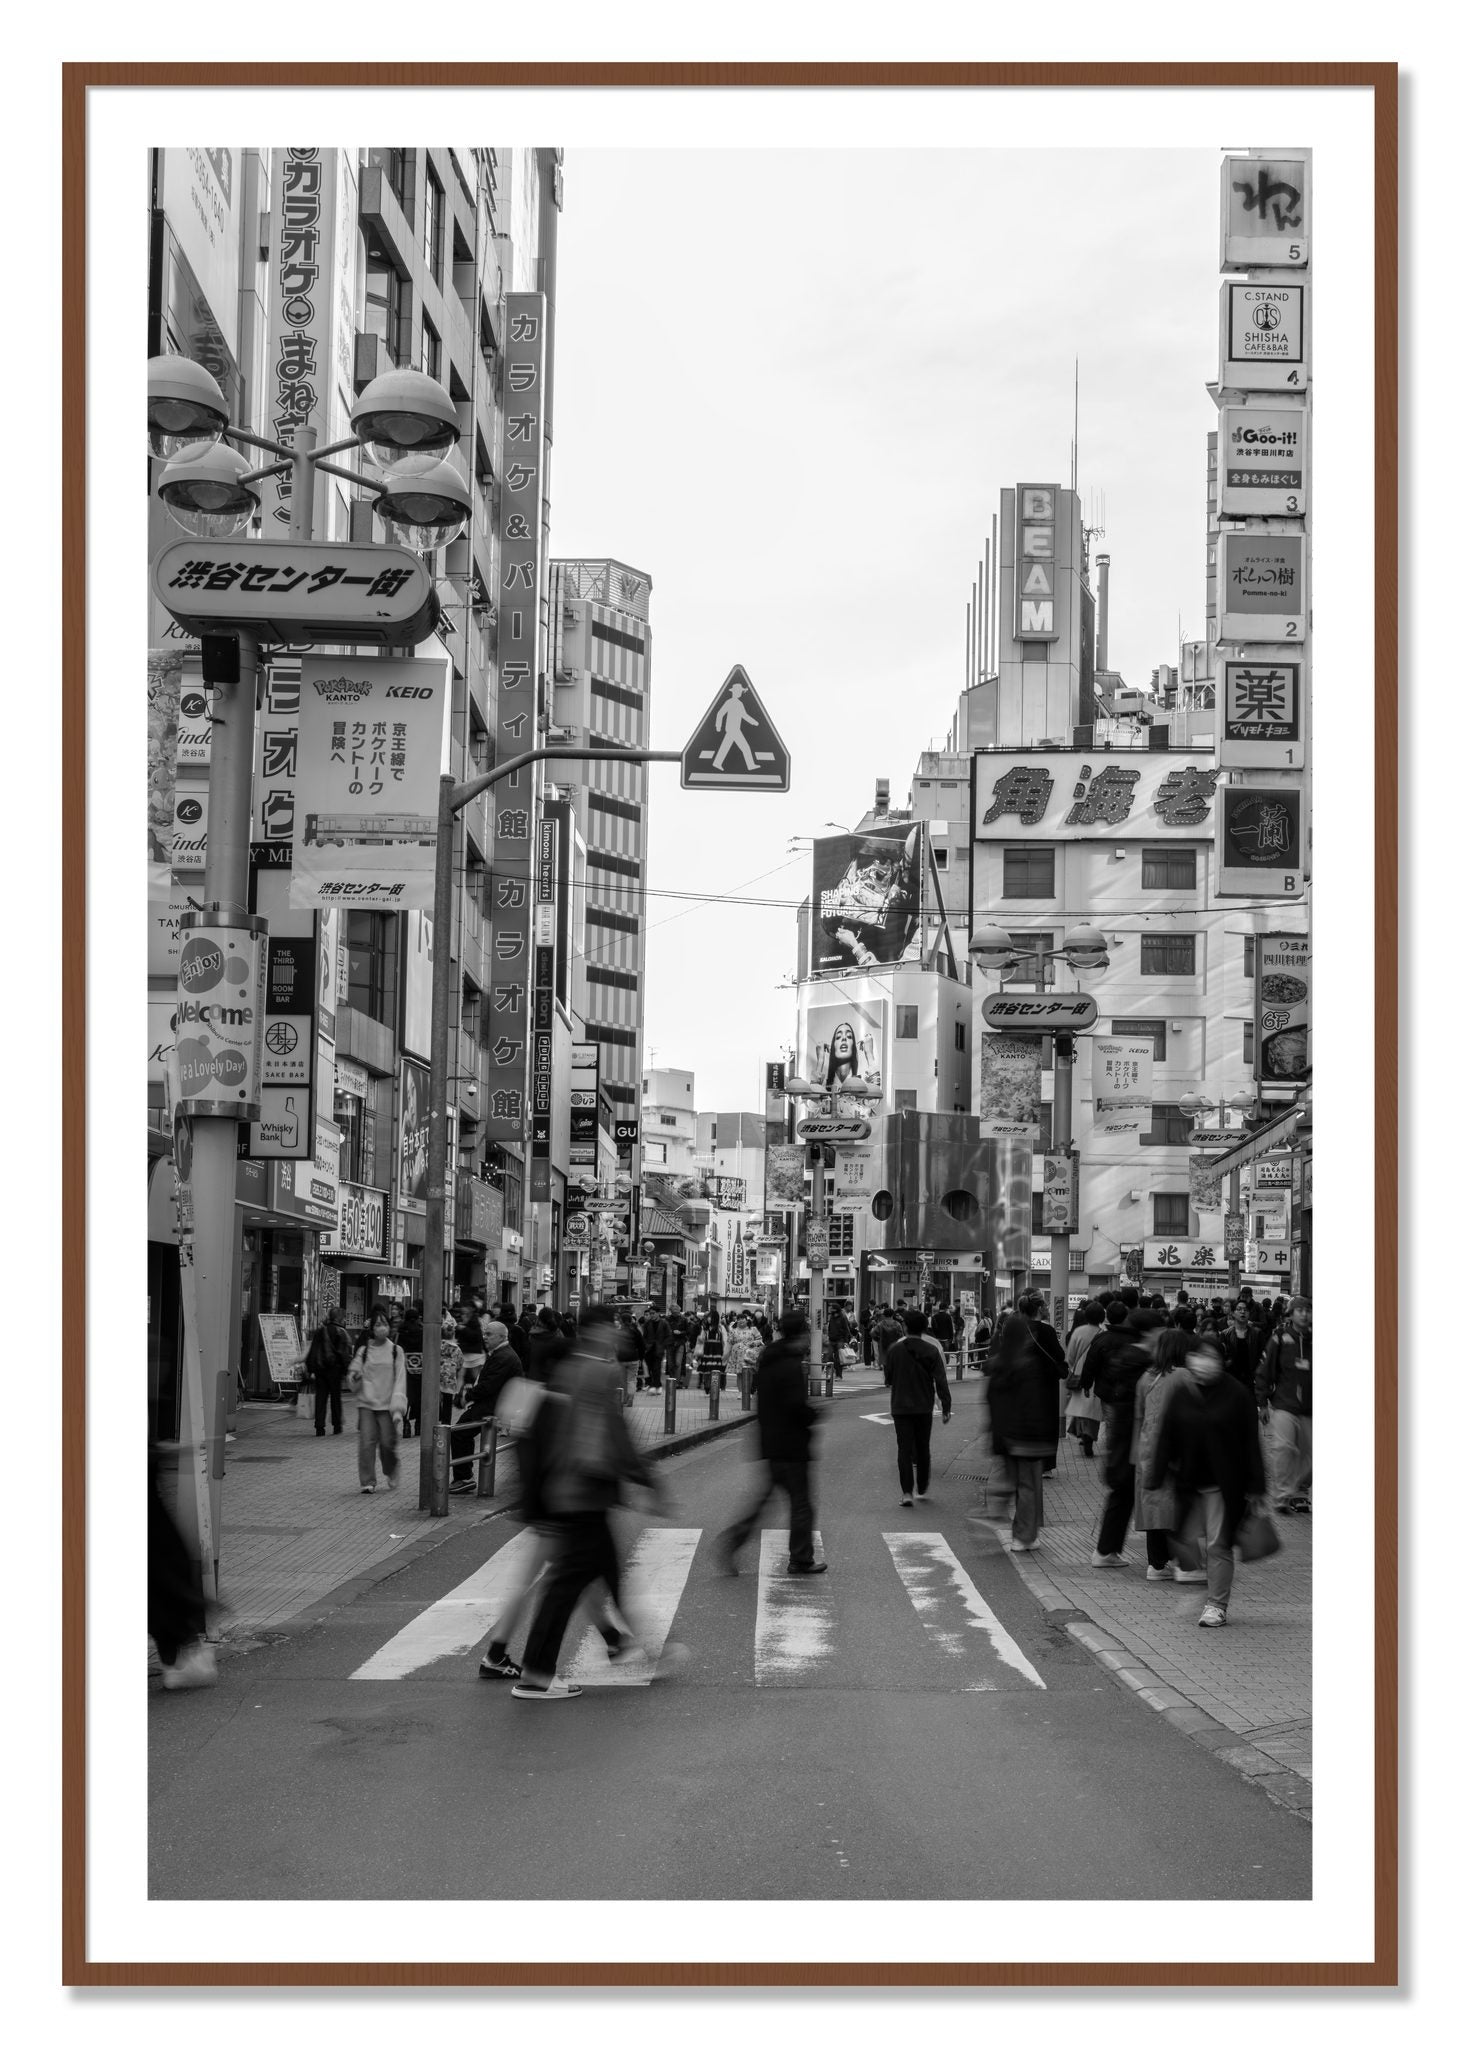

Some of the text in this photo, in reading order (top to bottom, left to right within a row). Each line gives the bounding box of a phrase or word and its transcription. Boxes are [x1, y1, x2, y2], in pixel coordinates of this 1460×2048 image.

[281, 160, 322, 299] カラオケ
[1289, 245, 1301, 261] 5
[1244, 292, 1289, 302] C.STAND
[1244, 332, 1289, 343] SHISHA
[1244, 343, 1289, 352] CAFE&BAR
[1287, 370, 1299, 385] 4
[1243, 428, 1297, 445] Goo-it!
[1231, 473, 1298, 485] 全身もみほぐし
[1286, 495, 1298, 512] 3
[1023, 489, 1053, 633] BEAM
[168, 559, 416, 598] 渋谷センター街
[1242, 589, 1287, 597] Pomme-no-ki
[1285, 621, 1297, 637] 2
[325, 694, 361, 702] KANTO
[385, 686, 434, 700] KEIO
[1235, 669, 1286, 721] 薬
[1229, 723, 1291, 738] マツモトキヨシ
[330, 721, 347, 764] 冒険へ
[181, 748, 206, 758] 渋谷店
[349, 721, 366, 795] カントーの
[368, 721, 387, 796] ポケパーク
[390, 722, 407, 782] 京王線で
[1285, 748, 1293, 764] 1
[982, 764, 1220, 826] 角海老
[1230, 803, 1290, 852] 一蘭
[177, 854, 202, 864] 渋谷店
[542, 824, 551, 899] kimono hearts
[317, 882, 406, 896] 渋谷センター街
[1284, 875, 1296, 891] B
[272, 957, 295, 965] THIRD
[819, 955, 843, 963] SALOMON
[181, 951, 221, 986] Enjoy
[272, 985, 294, 993] ROOM
[539, 951, 551, 1025] disk union
[275, 995, 290, 1003] BAR
[178, 1000, 254, 1026] Welcome
[989, 1002, 1091, 1016] 渋谷センター街
[1262, 1011, 1290, 1031] 6F
[194, 1058, 224, 1078] Lovely
[225, 1059, 245, 1073] Day!
[260, 1133, 280, 1141] Bank
[261, 1123, 294, 1135] Whisky
[617, 1126, 637, 1138] GU
[1157, 1244, 1216, 1266] 兆楽
[734, 1243, 742, 1285] BEER
[731, 1286, 744, 1294] HALL
